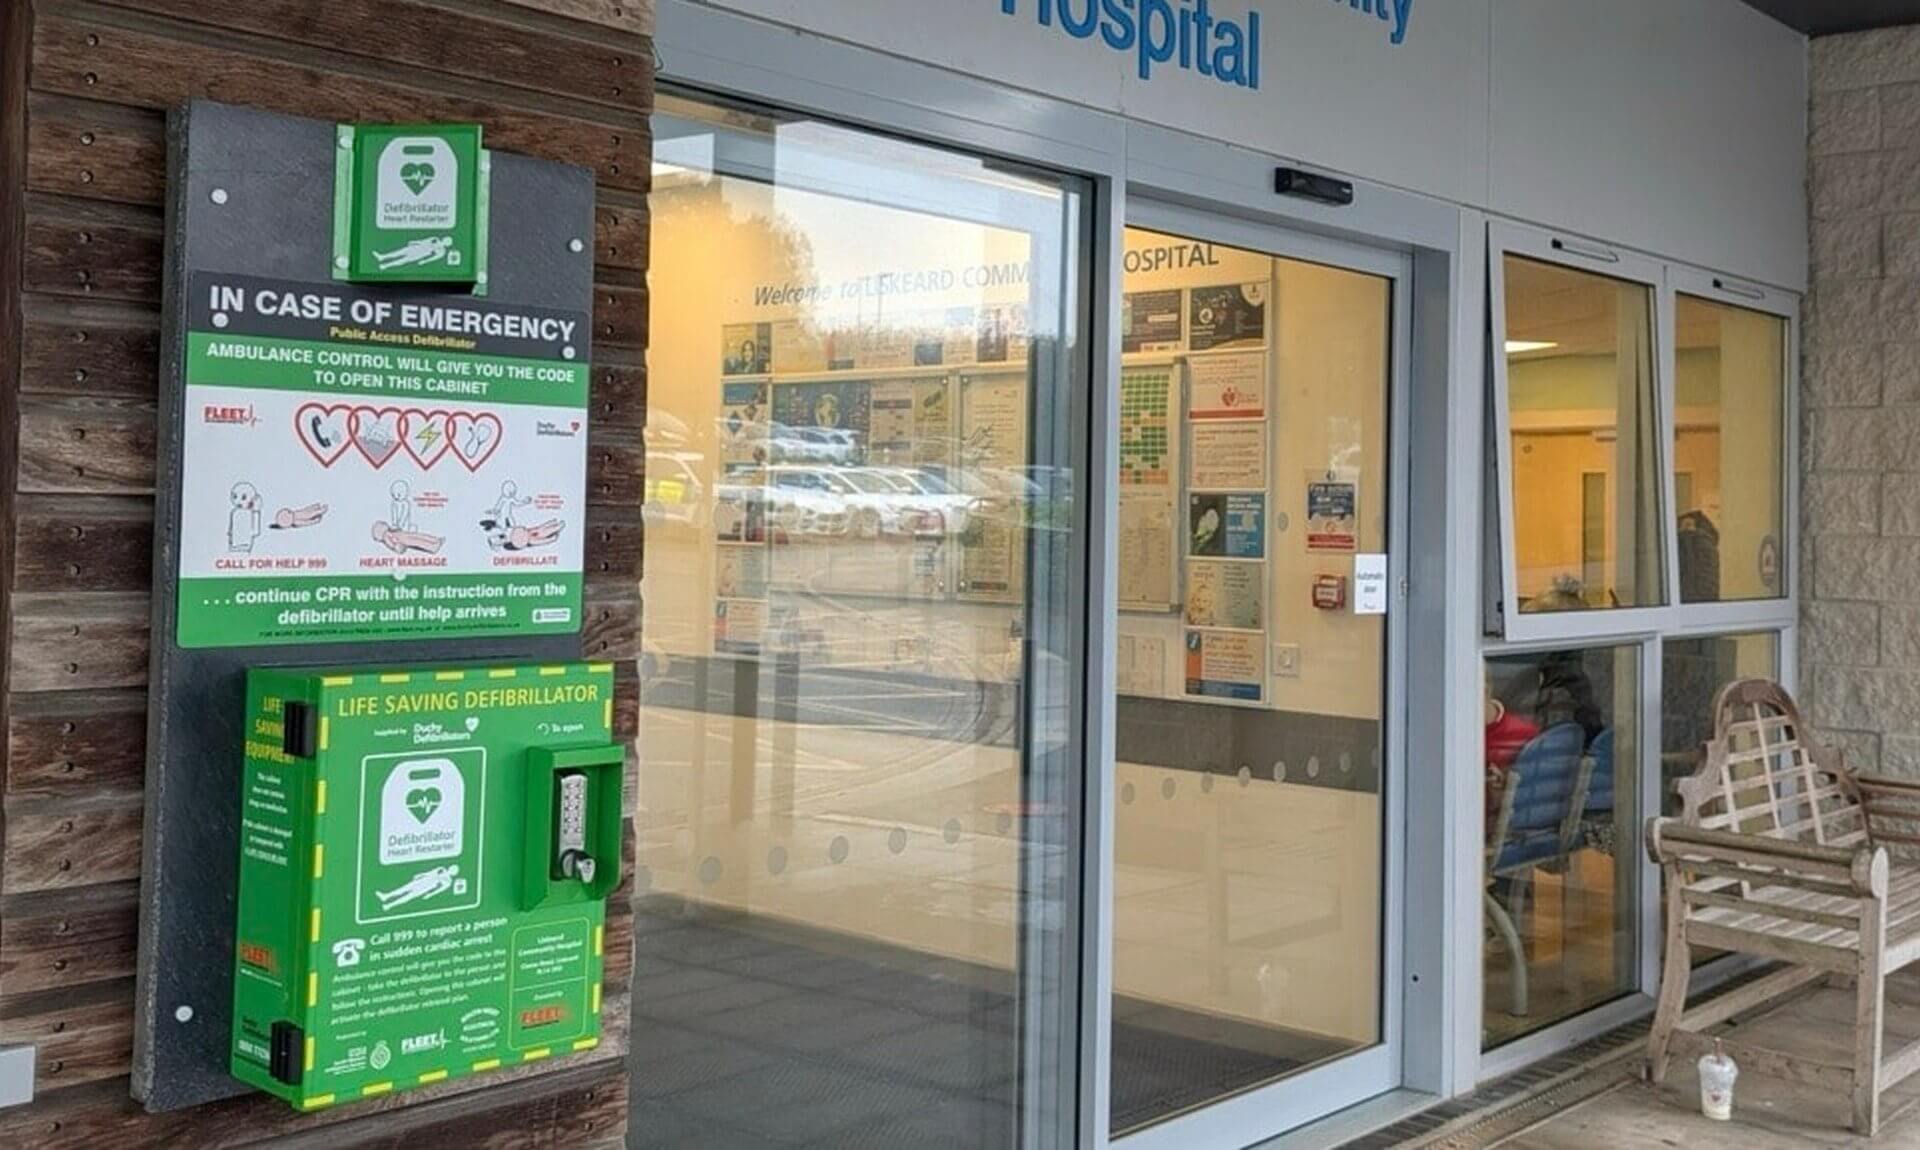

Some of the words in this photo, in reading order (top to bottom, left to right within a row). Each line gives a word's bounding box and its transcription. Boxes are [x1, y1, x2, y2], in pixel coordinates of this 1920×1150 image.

[1001, 0, 1260, 89] ospital
[383, 202, 450, 214] Defibrillator
[383, 214, 407, 223] Heart
[754, 282, 832, 306] Welcome
[963, 262, 1032, 288] COMM
[1123, 243, 1220, 274] OSPITAL
[209, 285, 244, 312] IN
[255, 290, 341, 321] CASE
[350, 299, 393, 325] OF
[401, 304, 576, 342] EMERGENCY
[329, 326, 367, 340] Public
[369, 330, 411, 344] Access
[412, 334, 477, 349] Defibrillator
[207, 342, 313, 364] AMBULANCE
[317, 351, 393, 370] CONTROL
[397, 357, 434, 372] WILL
[436, 361, 472, 376] GIVE
[474, 363, 503, 378] YOU
[507, 366, 535, 380] THE
[536, 368, 576, 383] CODE
[313, 370, 336, 385] TO
[339, 372, 383, 388] OPEN
[387, 375, 422, 390] THIS
[425, 377, 490, 395] CABINET
[204, 406, 246, 419] FLEET
[215, 558, 245, 570] CALL
[250, 558, 273, 569] FOR
[276, 557, 305, 569] HELP
[307, 557, 328, 568] 999
[359, 557, 394, 568] HEART
[397, 556, 448, 567] MASSAGE
[492, 555, 559, 567] DEFIBRILLATE
[235, 588, 311, 605] continue
[315, 586, 352, 602] CPR
[356, 586, 390, 601] with
[394, 586, 419, 600] the
[423, 583, 504, 599] instruction
[507, 583, 541, 598] from
[544, 582, 567, 597] the
[278, 608, 375, 625] defibrillator
[379, 606, 415, 621] until
[418, 605, 452, 623] help
[455, 604, 507, 619] arrives
[263, 696, 282, 713] LIFE
[339, 696, 379, 717] LIFE
[384, 691, 459, 715] SAVING
[465, 684, 599, 709] DEFIBRILLATOR
[413, 723, 443, 735] Duchy
[387, 831, 456, 847] Defibrillator
[370, 933, 391, 946] Call
[393, 930, 414, 943] 999
[416, 928, 428, 939] to
[429, 922, 463, 938] report
[465, 922, 471, 931] a
[473, 917, 508, 931] person
[369, 950, 381, 962] in
[383, 945, 423, 960] sudden
[424, 938, 462, 953] cardiac
[464, 933, 493, 947] arrest
[401, 1032, 438, 1050] FLEET
